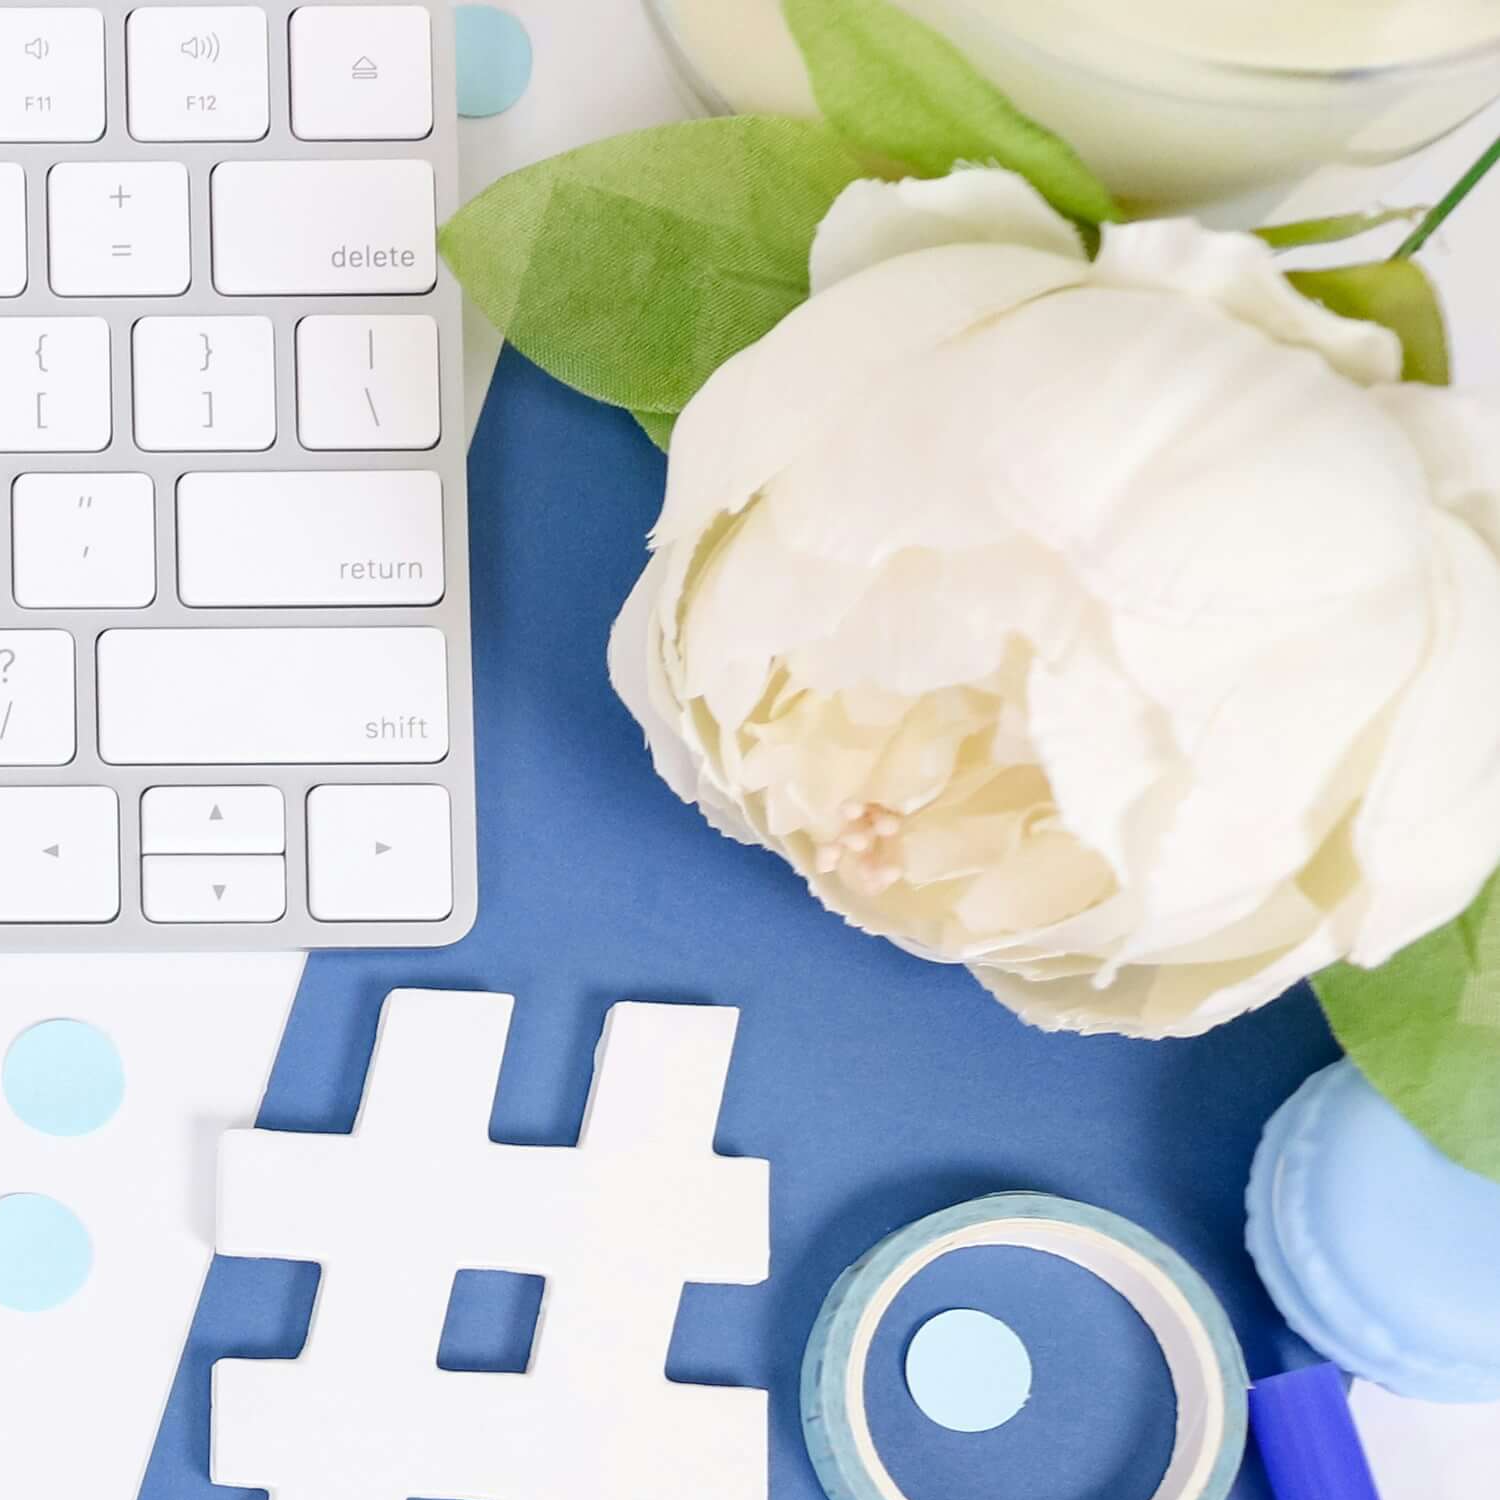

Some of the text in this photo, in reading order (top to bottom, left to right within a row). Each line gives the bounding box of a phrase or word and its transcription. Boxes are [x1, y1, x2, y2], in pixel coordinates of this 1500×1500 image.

[24, 95, 52, 112] F11
[186, 95, 217, 111] F12
[109, 184, 132, 209] +
[331, 244, 416, 268] delete
[34, 333, 49, 373] {
[199, 333, 213, 372] }
[36, 391, 49, 430] [
[201, 391, 214, 429] ]
[340, 559, 423, 580] return
[365, 715, 428, 739] shift
